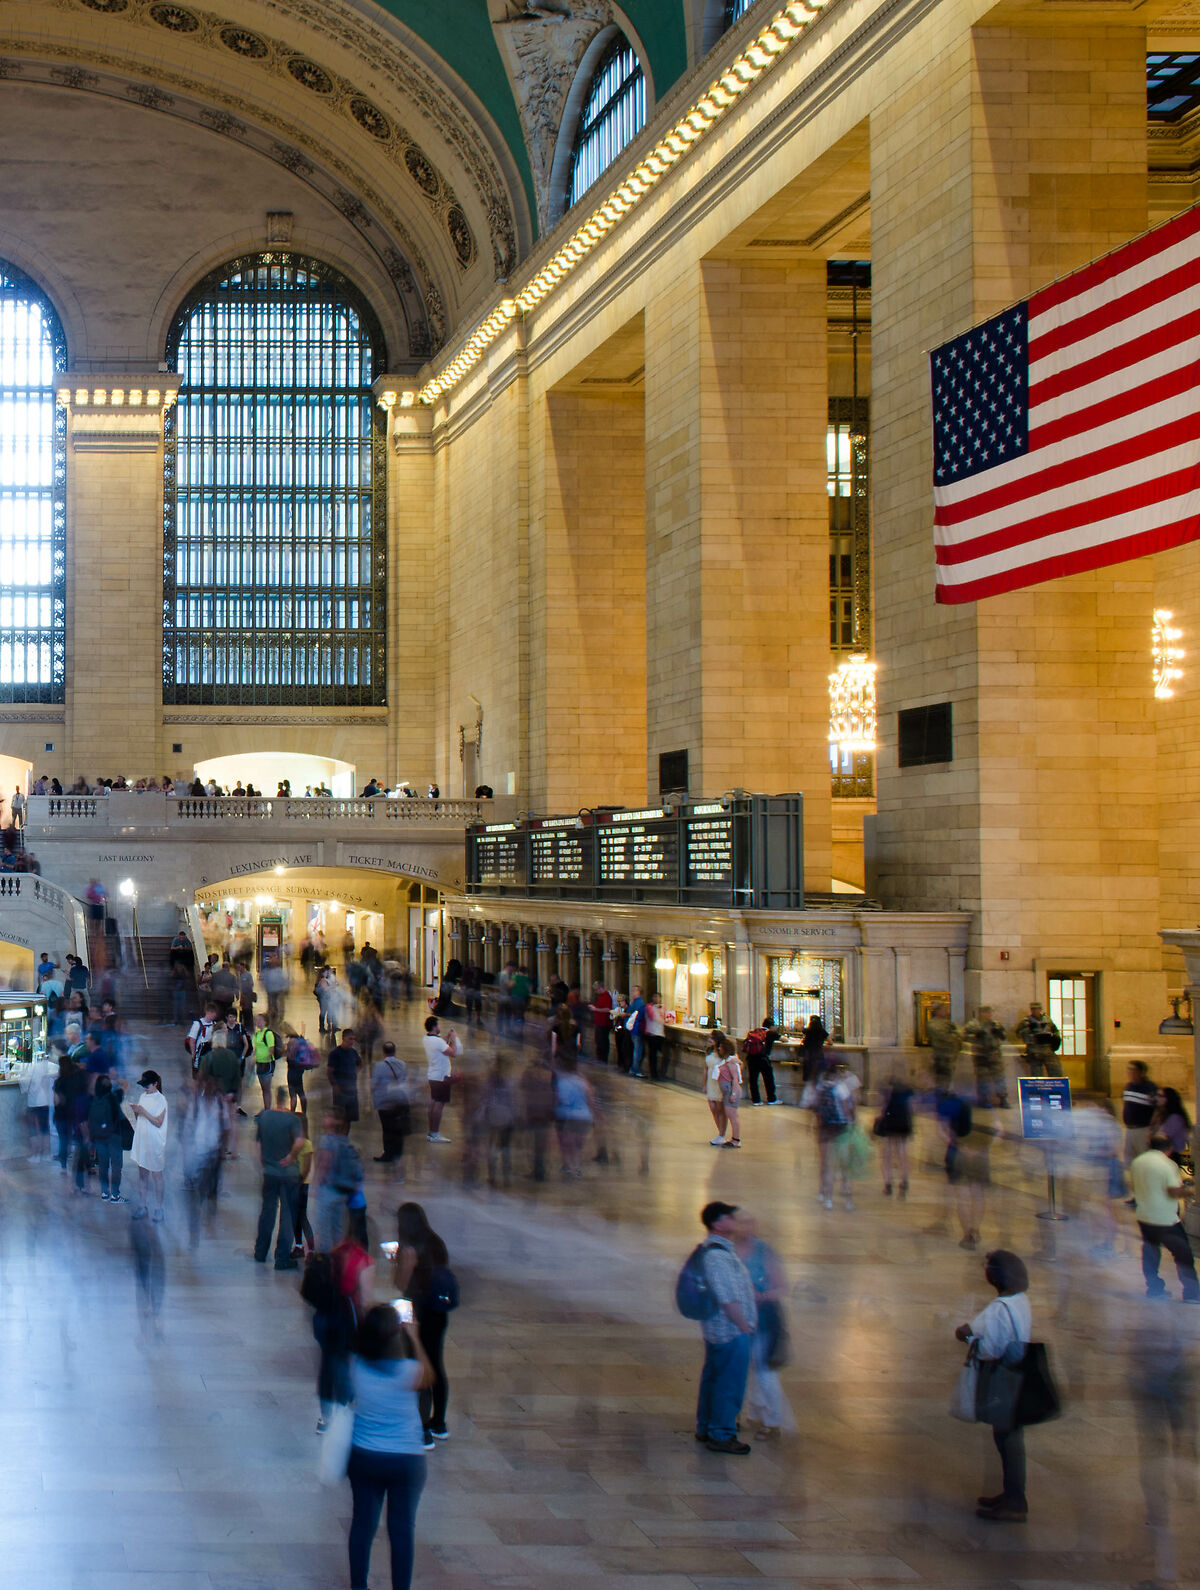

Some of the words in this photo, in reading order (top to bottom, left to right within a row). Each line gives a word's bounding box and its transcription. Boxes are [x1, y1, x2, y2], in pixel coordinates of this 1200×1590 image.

[230, 857, 290, 875] LEXINGTON
[293, 855, 312, 864] AVE
[349, 855, 384, 867] TICKET
[387, 860, 440, 879] MACHINES
[212, 887, 243, 897] STREET
[246, 886, 281, 894] PASSAGE
[286, 886, 322, 896] SUBWAY
[760, 927, 799, 935] CUSTOMER
[801, 928, 836, 936] SERVICE
